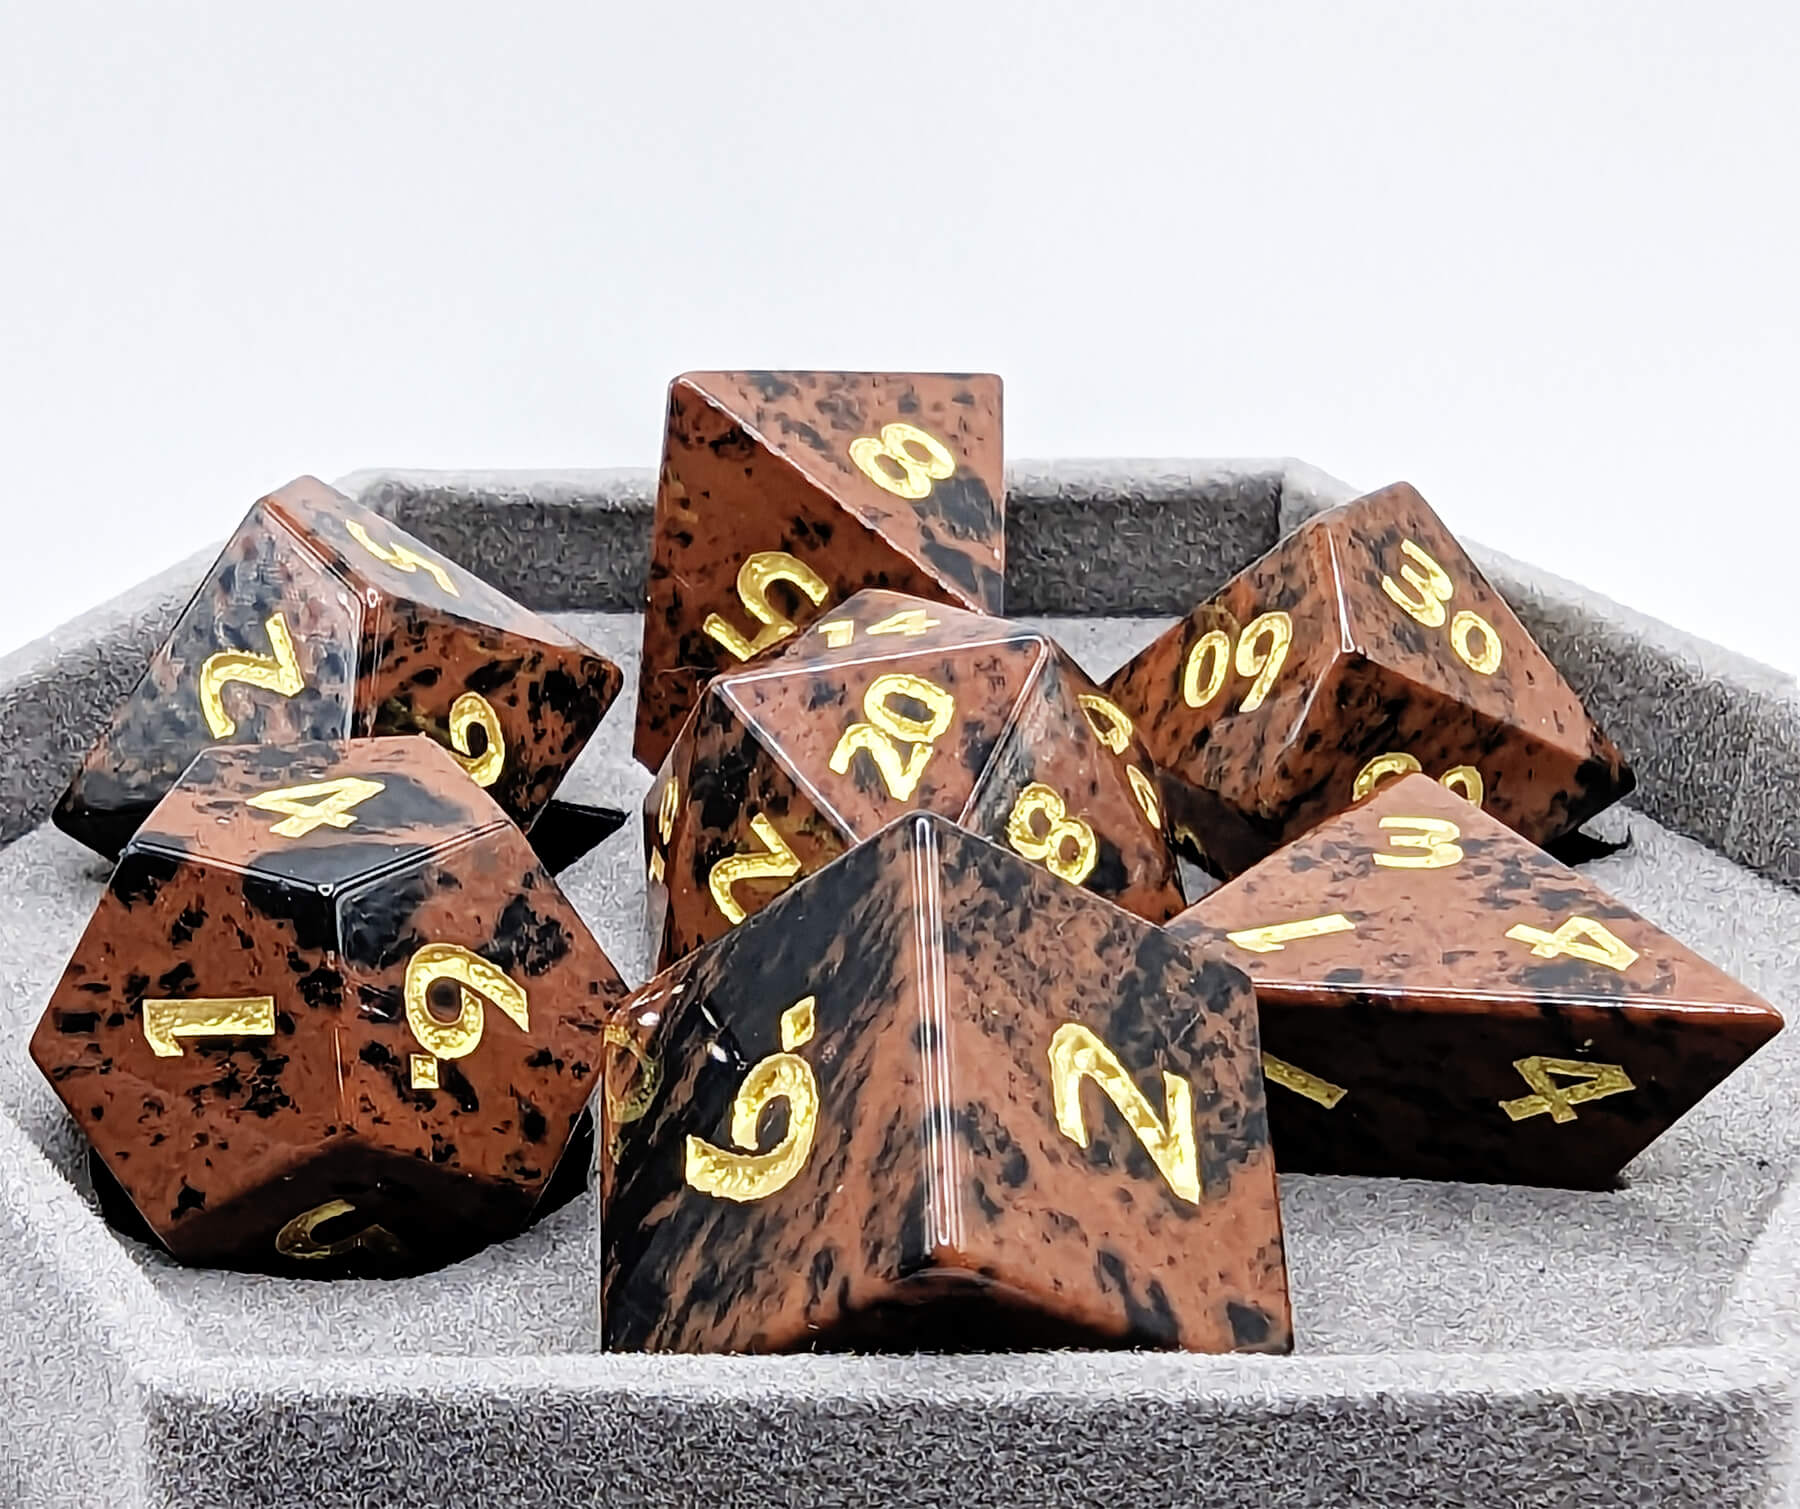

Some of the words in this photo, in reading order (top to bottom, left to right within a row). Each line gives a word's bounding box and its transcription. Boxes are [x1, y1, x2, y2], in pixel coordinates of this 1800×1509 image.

[848, 422, 956, 500] 8
[703, 551, 829, 662] 5
[828, 673, 954, 802] 20
[245, 777, 386, 838] 4
[1006, 782, 1097, 887] 8
[1373, 815, 1465, 870] 3
[1504, 914, 1640, 972] 4
[142, 995, 275, 1058] 1
[1498, 1055, 1637, 1123] 4
